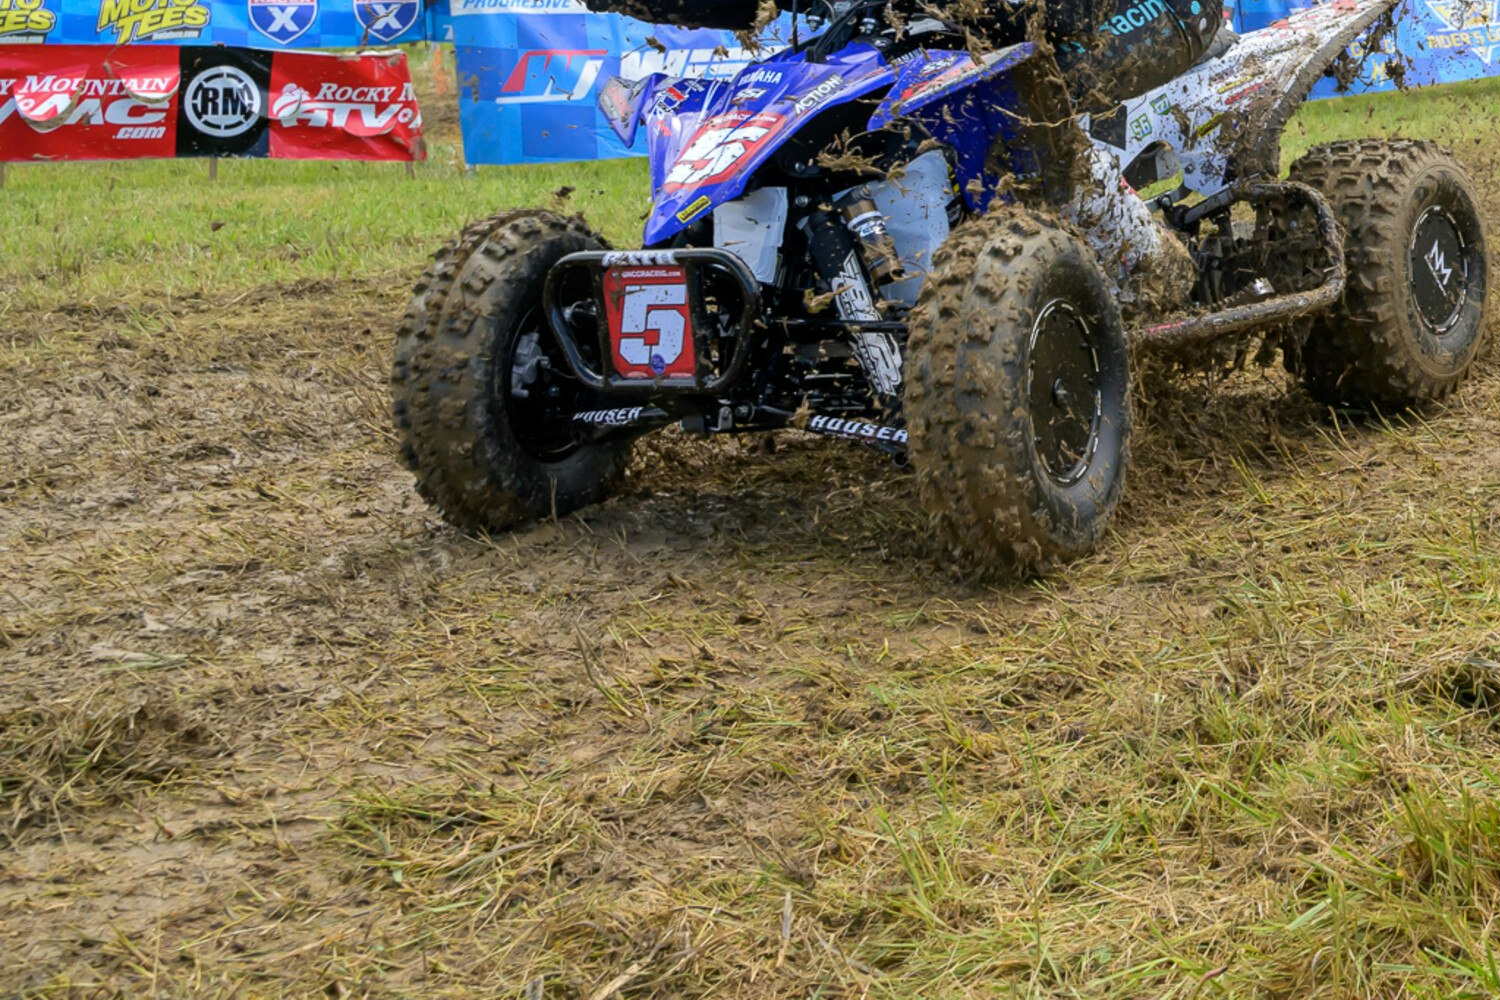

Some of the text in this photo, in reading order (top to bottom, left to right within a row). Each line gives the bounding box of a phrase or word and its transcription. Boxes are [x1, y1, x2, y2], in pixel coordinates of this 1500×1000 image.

[115, 6, 209, 45] TEES
[266, 6, 300, 32] X
[371, 3, 403, 30] X
[203, 87, 250, 116] RM
[314, 82, 397, 103] ROCKY
[663, 125, 773, 186] 5
[619, 283, 687, 366] 5
